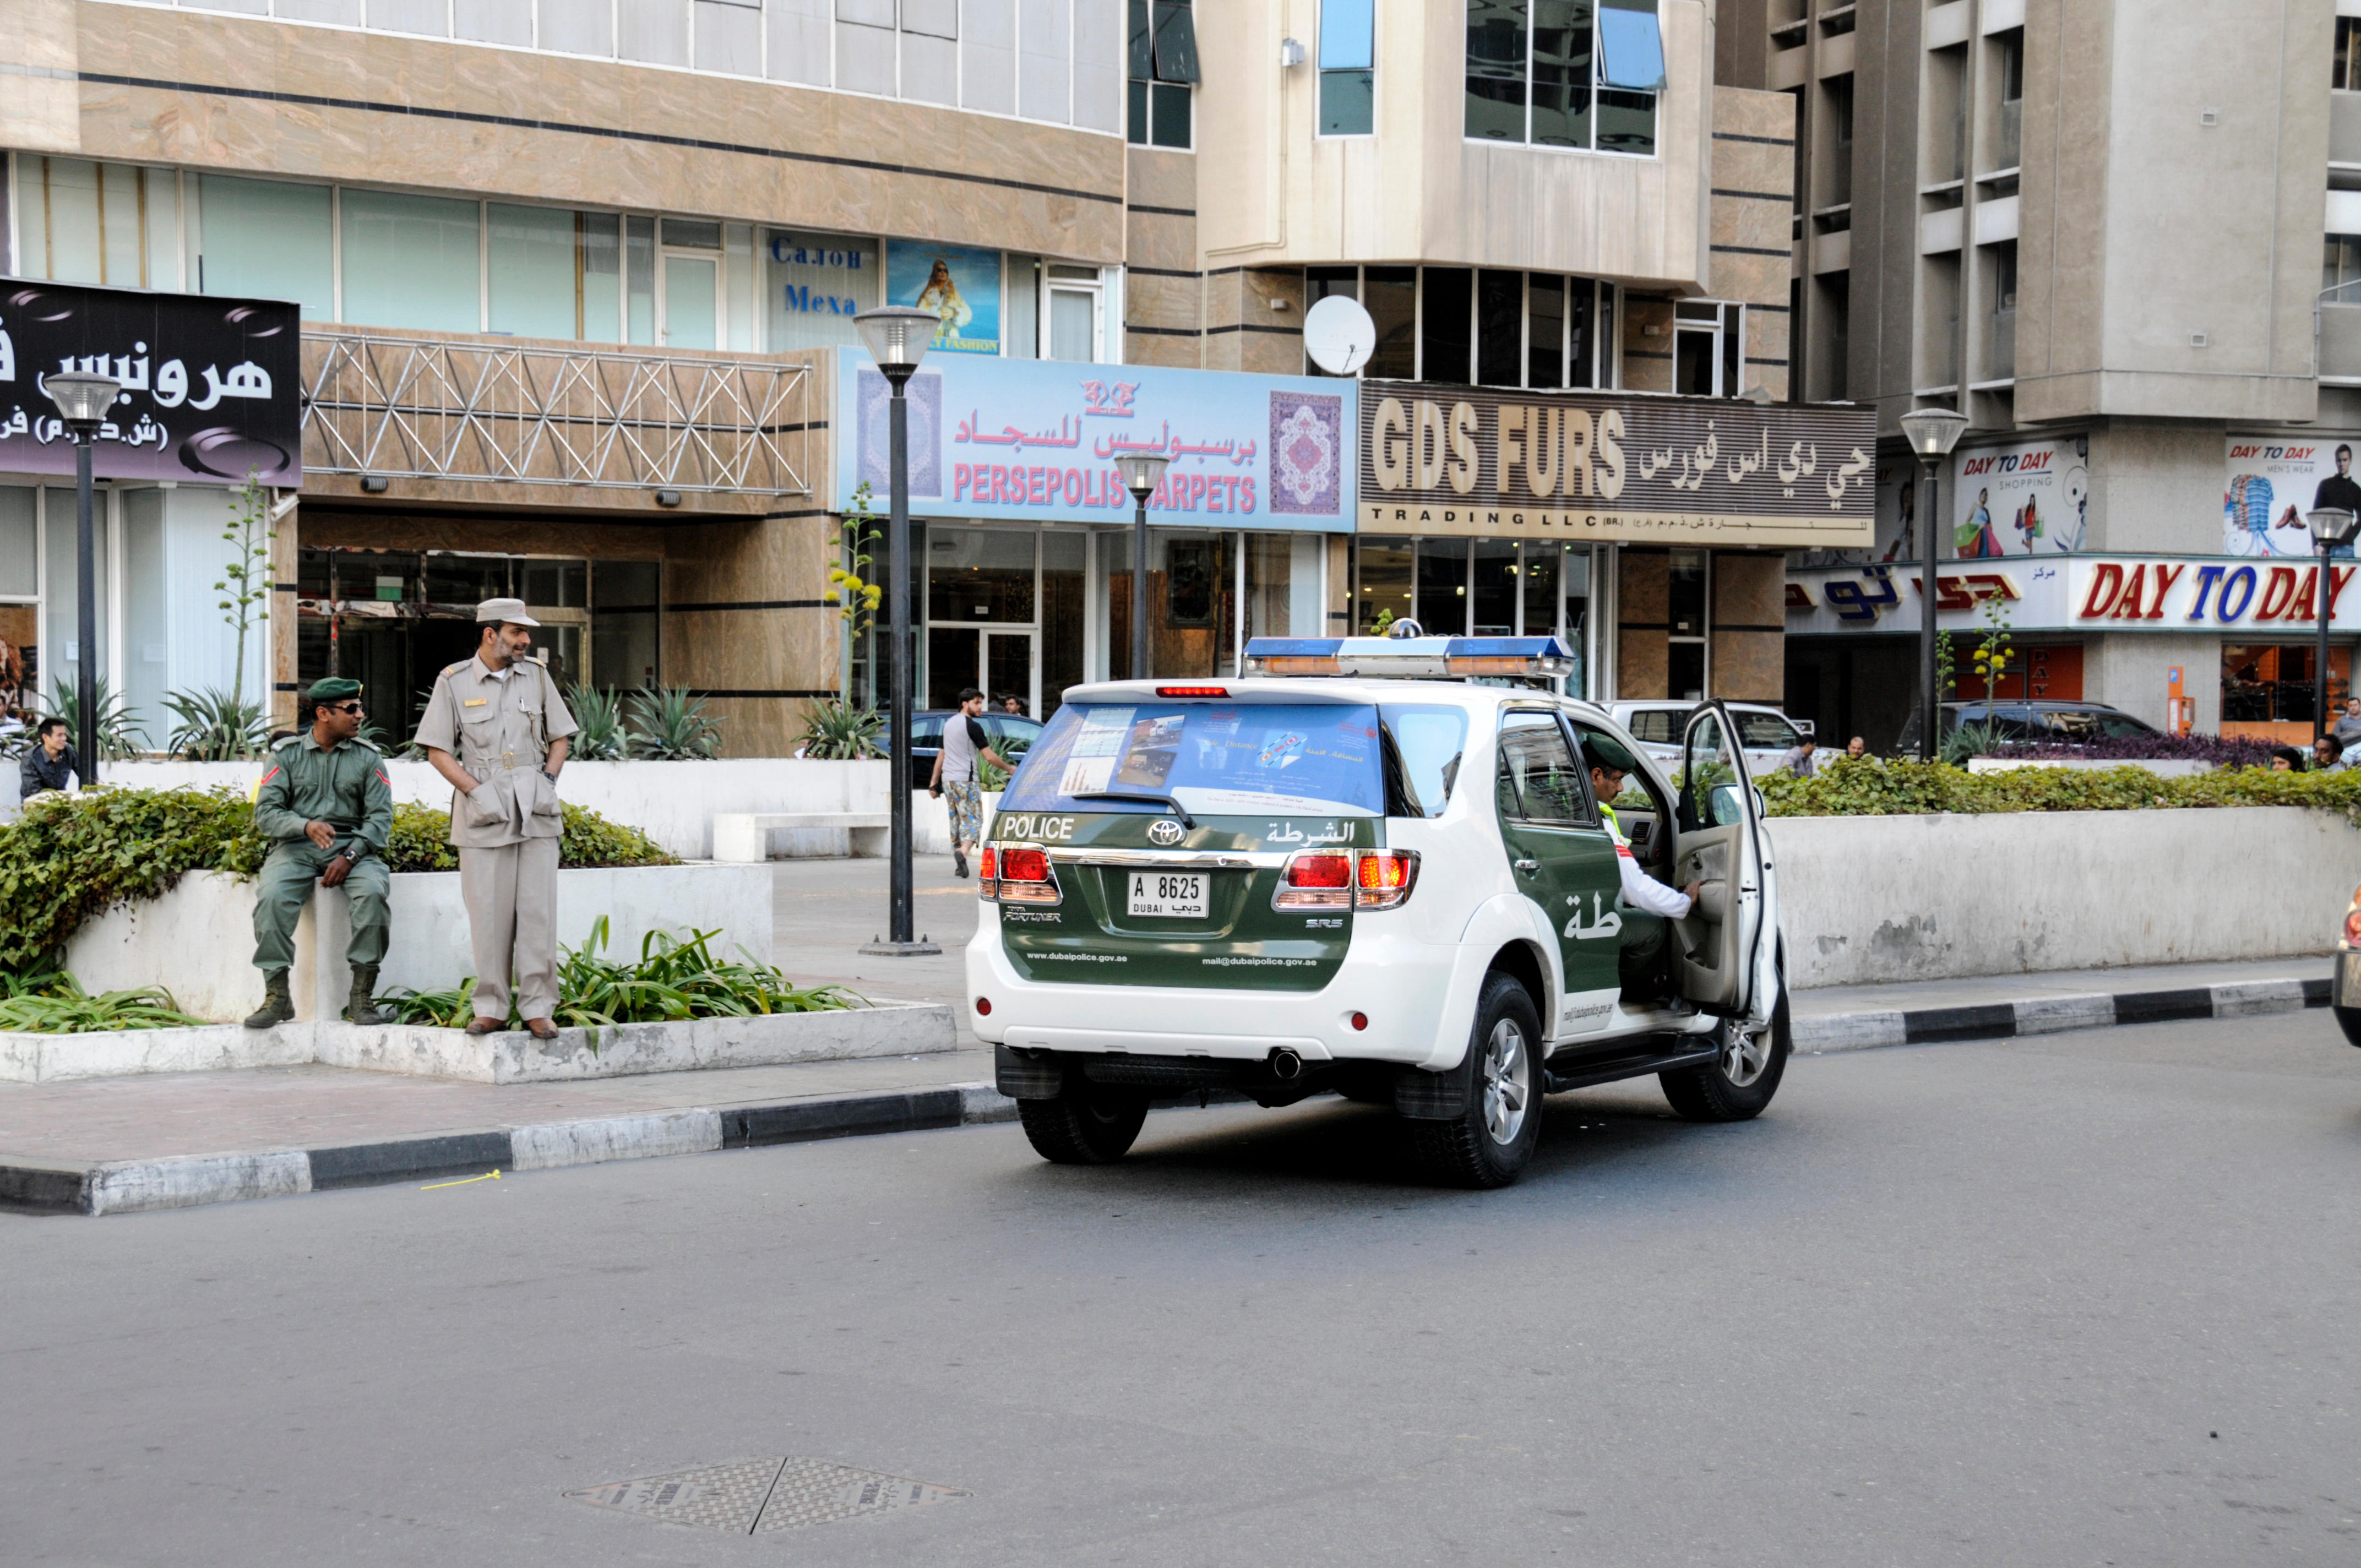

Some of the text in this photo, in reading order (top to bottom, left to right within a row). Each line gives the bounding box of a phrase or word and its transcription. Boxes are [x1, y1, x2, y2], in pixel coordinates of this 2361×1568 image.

[772, 237, 861, 269] Салон
[785, 284, 857, 315] Меха
[945, 339, 998, 352] FASHION
[955, 409, 1081, 453] للسجاد
[1372, 397, 1626, 499] GDS FURS
[1639, 419, 1718, 491] فورس
[2229, 445, 2316, 460] DAY TO DAY
[1778, 440, 1816, 497] دي
[1963, 451, 2054, 476] DAY TO DAY
[2267, 465, 2314, 474] MEN'S WEAR
[953, 462, 1256, 513] PERSEPOLIS ARPETS
[1826, 447, 1871, 510] جي
[1999, 477, 2053, 490] SHOPPING
[1372, 508, 1524, 525] TRADING
[2032, 567, 2055, 580] مركز
[2078, 563, 2357, 623] DAY TO DAY
[2032, 649, 2049, 696] DAY
[1226, 739, 1259, 749] Distance
[1003, 816, 1075, 840] POLICE
[1266, 821, 1354, 847] الشرطة
[1134, 876, 1199, 899] A 8625
[1003, 911, 1062, 923] FORTUNER
[1133, 903, 1162, 913] DUBAI
[1172, 905, 1201, 914] دبي
[1305, 919, 1343, 928] SR5
[1027, 952, 1128, 962] www.dubaipolice.gov.ae
[1202, 957, 1317, 967] mail@dubaipolice.gov.ae
